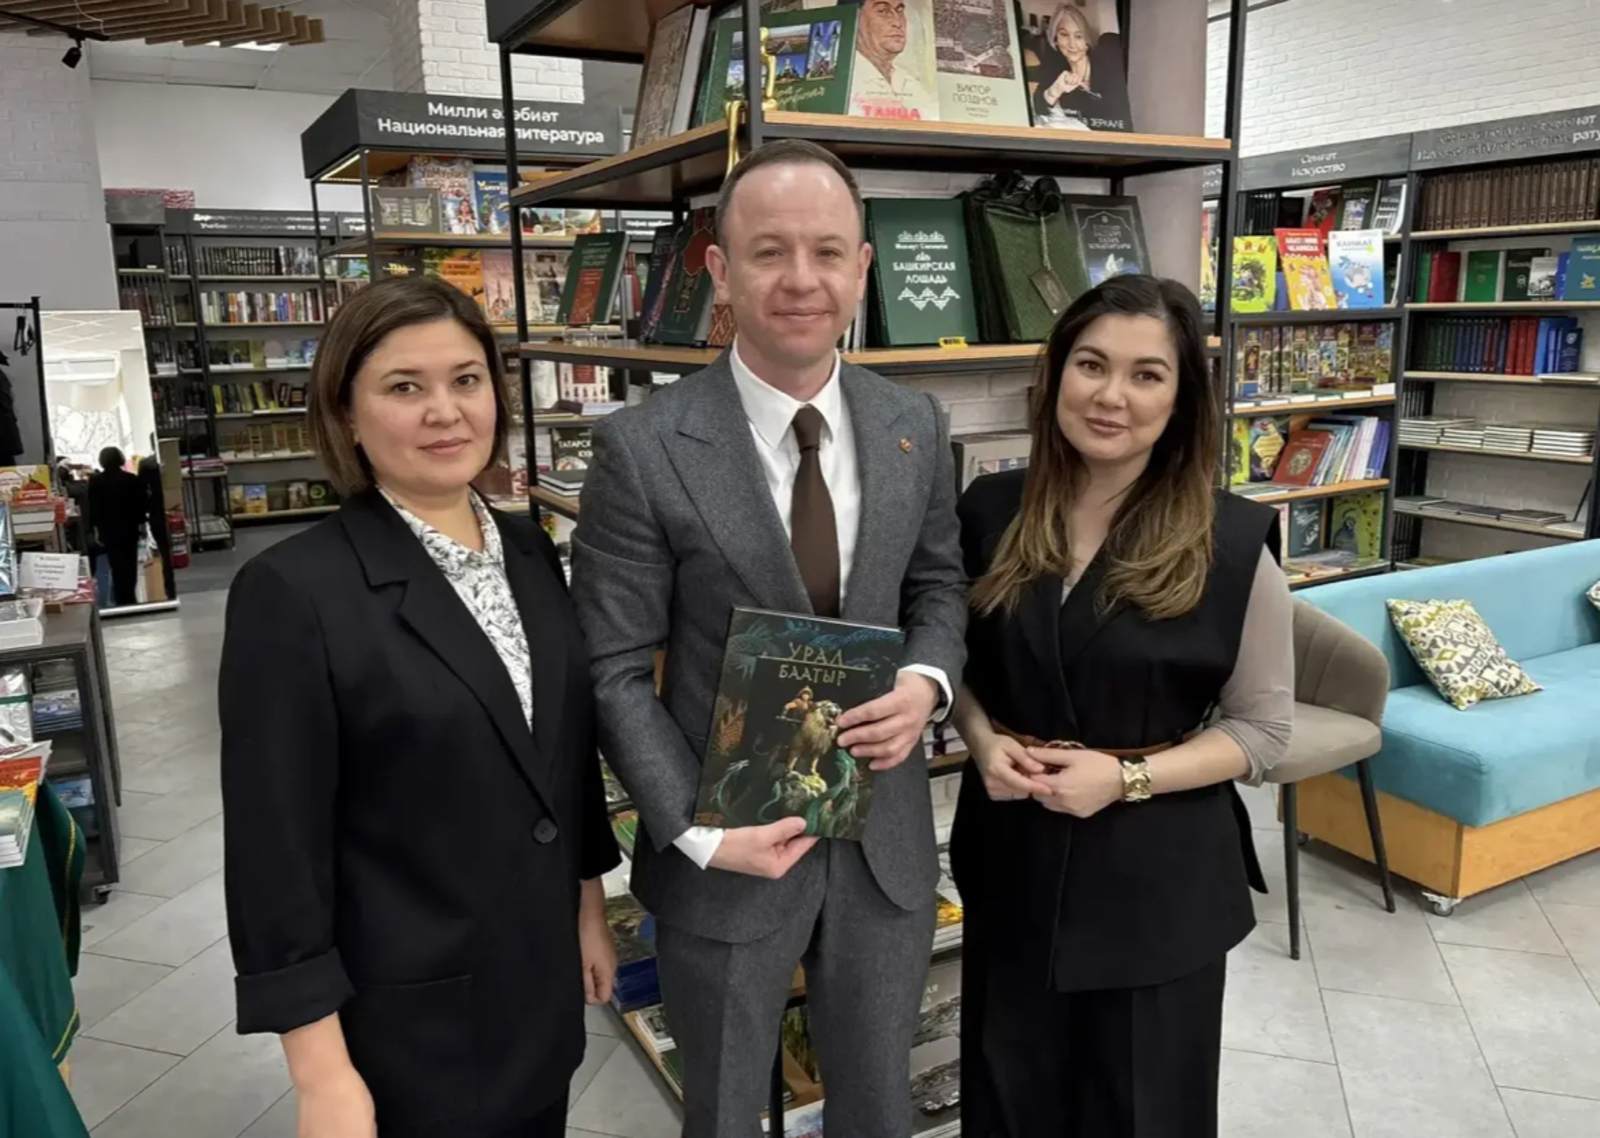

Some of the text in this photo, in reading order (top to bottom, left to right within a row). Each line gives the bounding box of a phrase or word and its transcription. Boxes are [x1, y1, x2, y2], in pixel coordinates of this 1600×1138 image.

[428, 102, 488, 119] Милли
[377, 118, 506, 138] Национальная
[893, 261, 956, 271] БАШКИРСКАЯ
[905, 274, 948, 284] ЛОШАДЬ
[788, 642, 844, 666] УРАЛ
